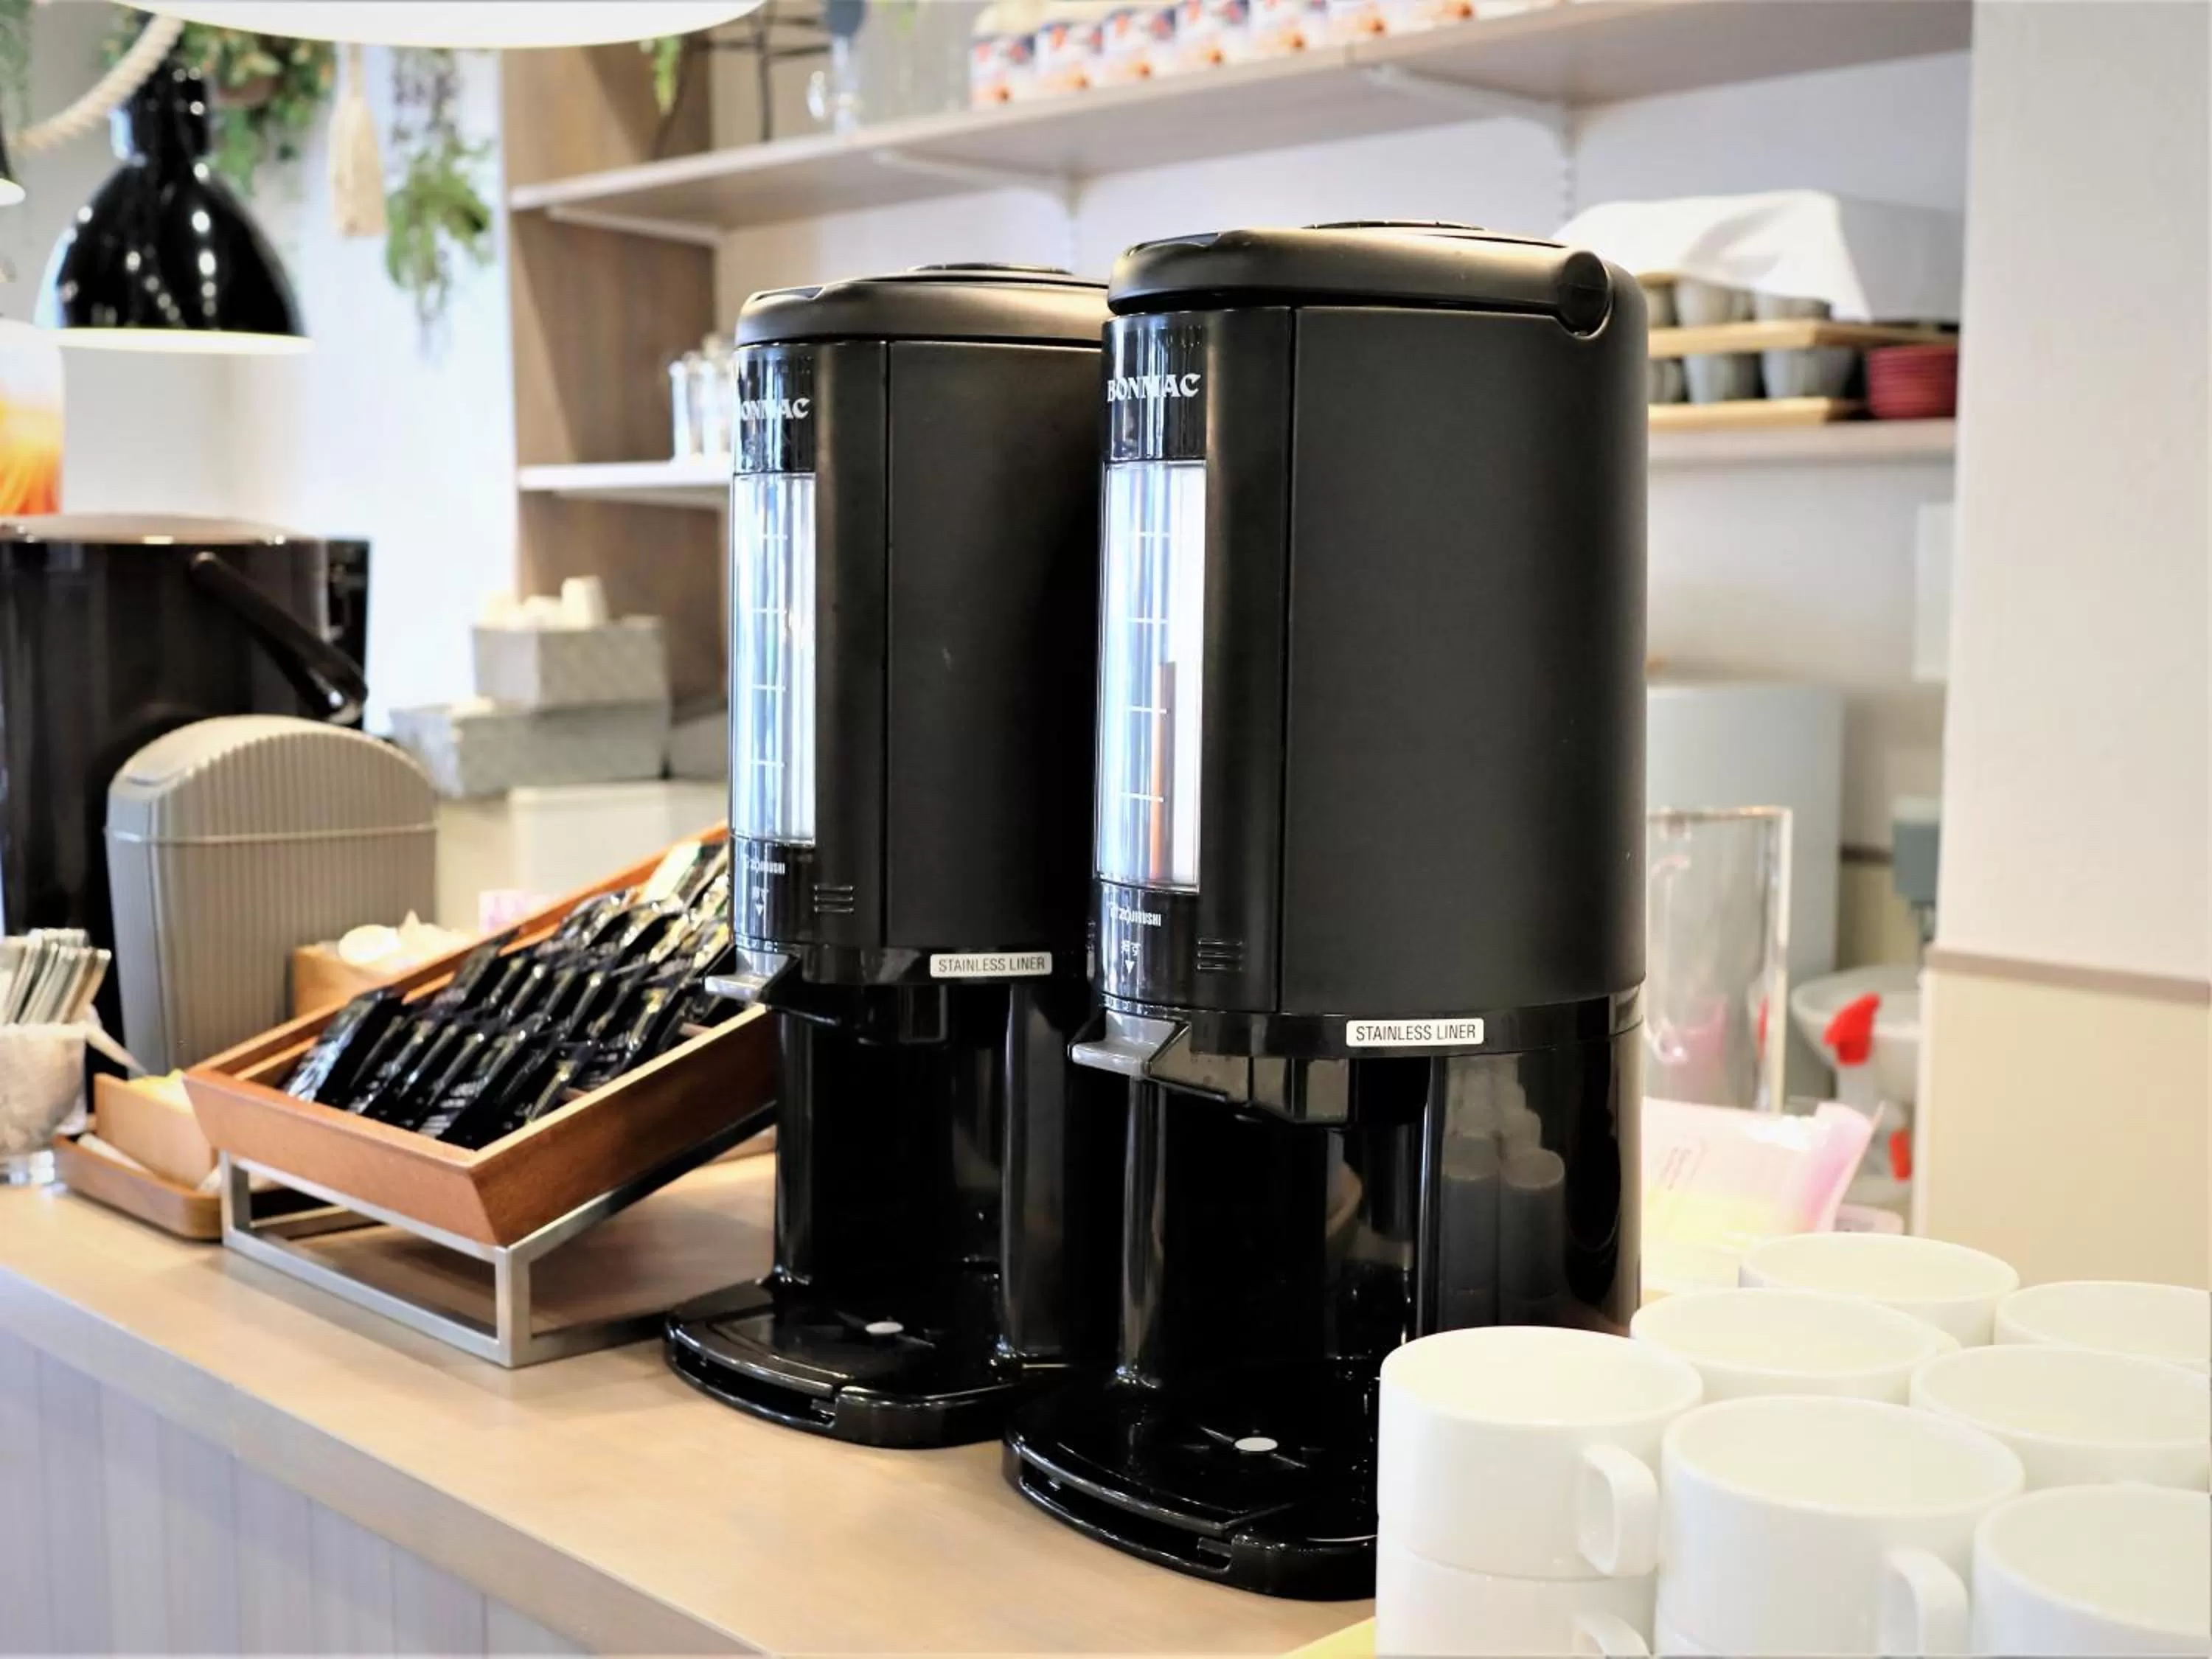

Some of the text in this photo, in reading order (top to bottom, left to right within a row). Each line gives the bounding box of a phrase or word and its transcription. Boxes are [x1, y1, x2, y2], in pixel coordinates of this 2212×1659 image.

[1107, 373, 1201, 403] BONMAC
[739, 397, 810, 421] ONMAC
[938, 956, 1046, 973] STAINLESS LINER
[1356, 1024, 1475, 1041] STAINLESS LINER
